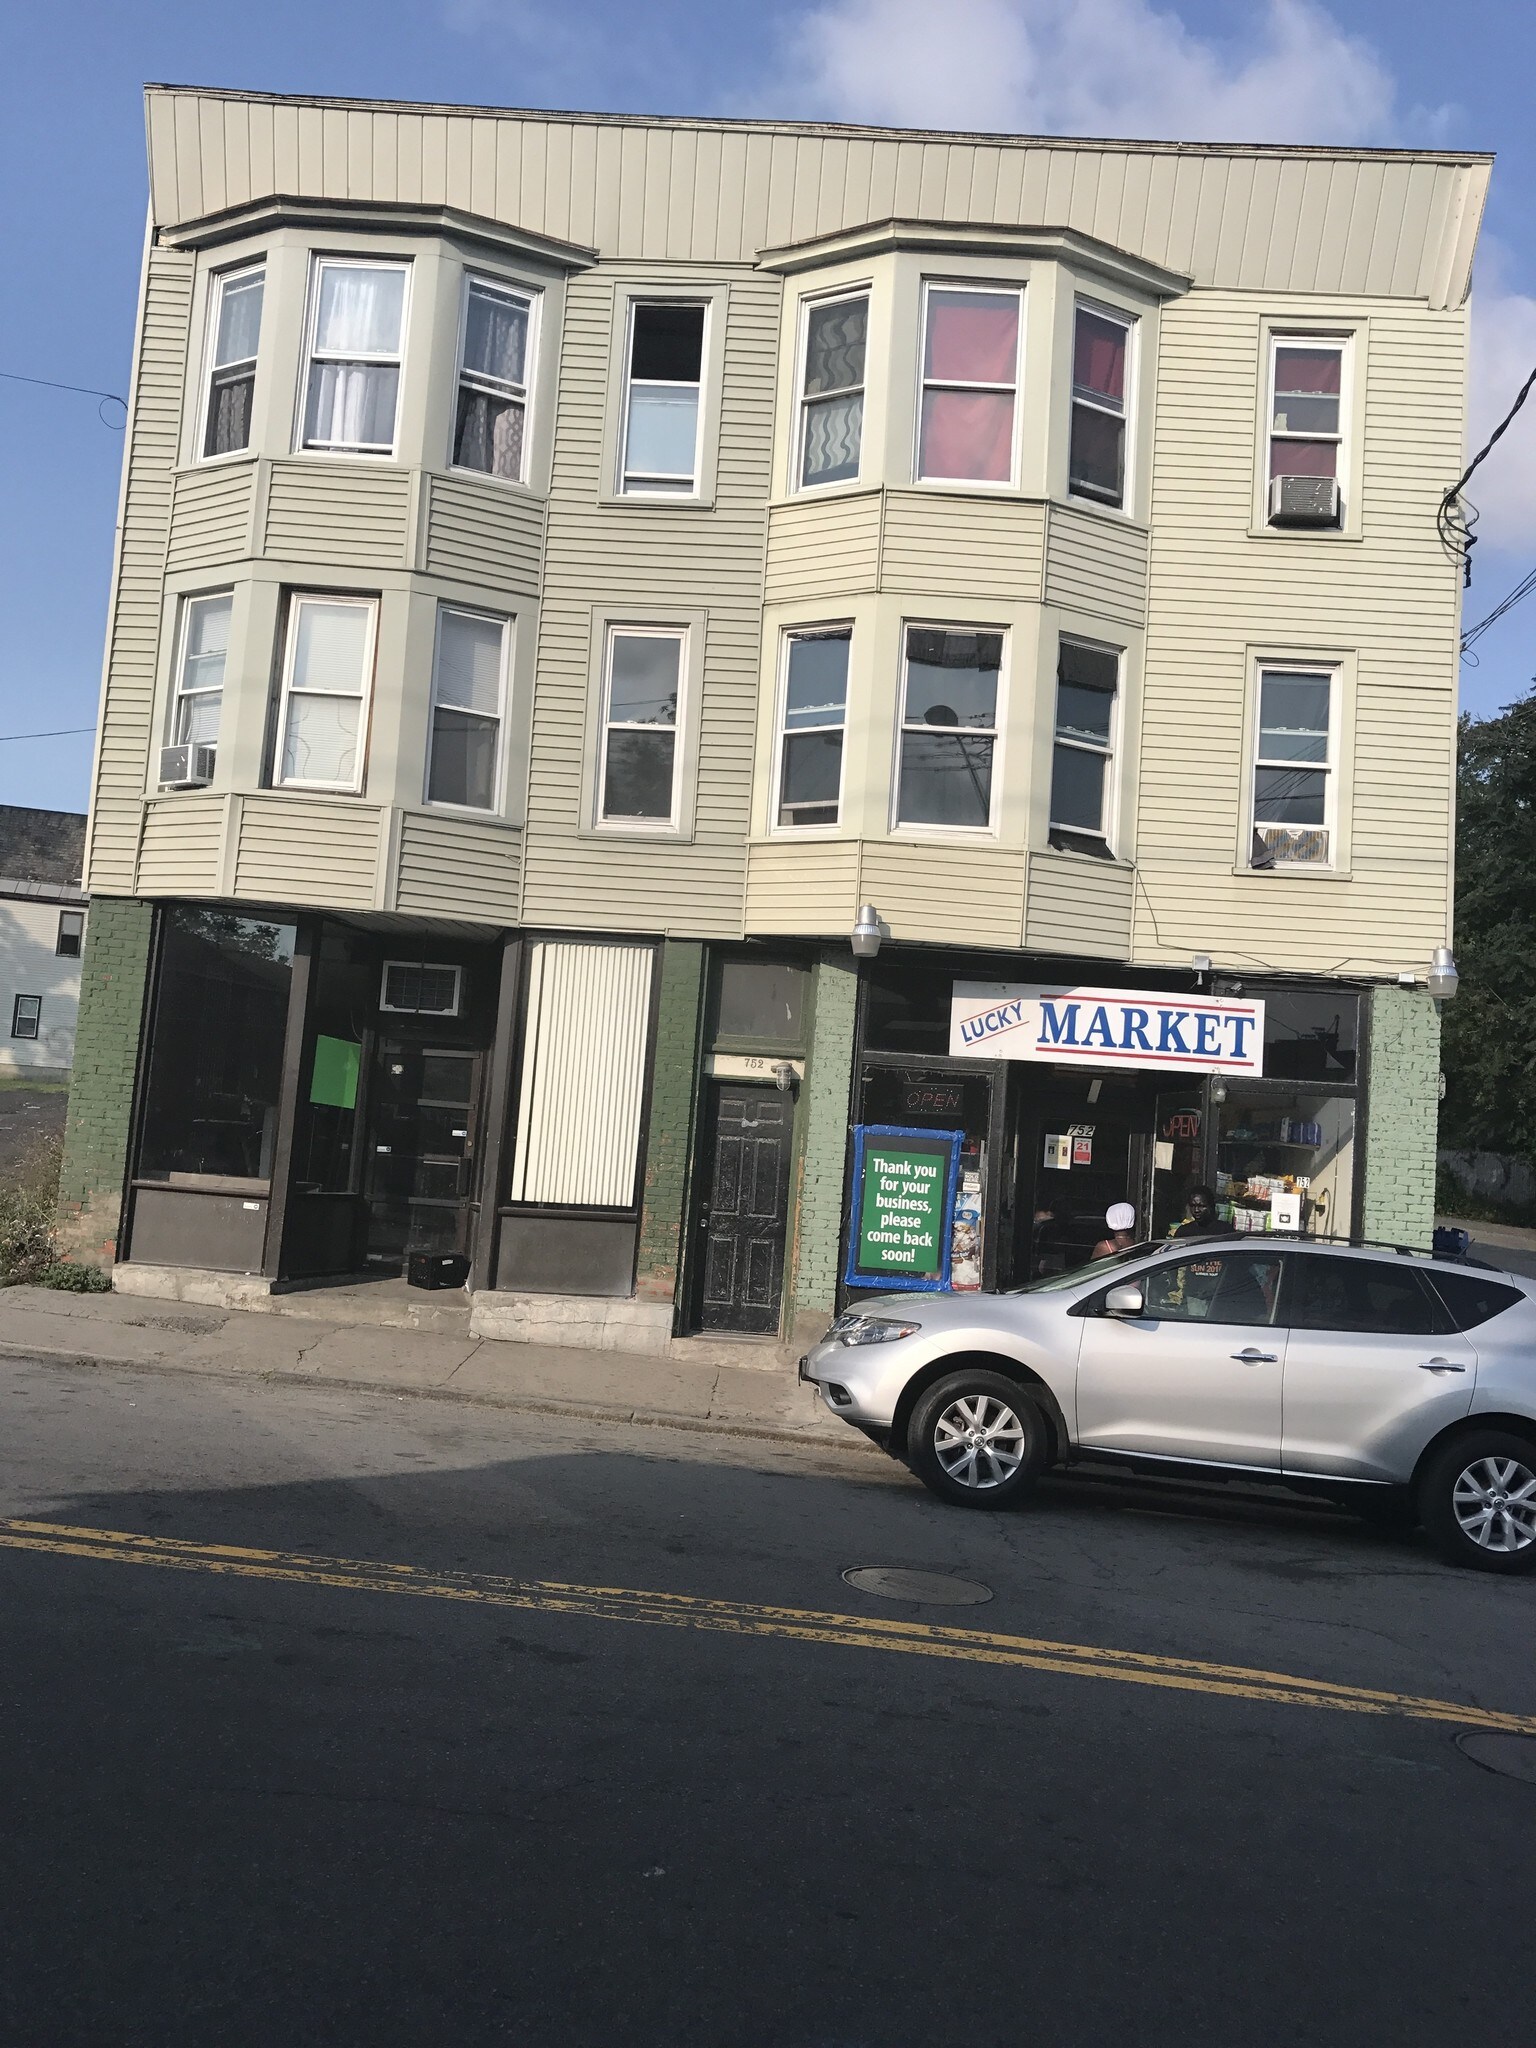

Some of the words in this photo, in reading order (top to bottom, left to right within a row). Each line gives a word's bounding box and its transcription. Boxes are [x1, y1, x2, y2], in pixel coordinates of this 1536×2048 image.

[960, 1002, 1022, 1043] LUCKY
[1037, 1002, 1256, 1058] MARKET
[744, 1058, 764, 1069] 752
[906, 1092, 960, 1107] OPEN
[1069, 1125, 1094, 1136] 752
[1076, 1142, 1089, 1151] 21
[873, 1158, 912, 1175] Thank
[913, 1166, 937, 1179] you
[880, 1176, 899, 1191] for
[902, 1181, 931, 1195] your
[1297, 1177, 1310, 1188] 752
[876, 1193, 932, 1214] business,
[880, 1211, 922, 1229] please
[867, 1230, 900, 1244] come
[903, 1230, 932, 1247] back
[881, 1248, 916, 1263] soon!
